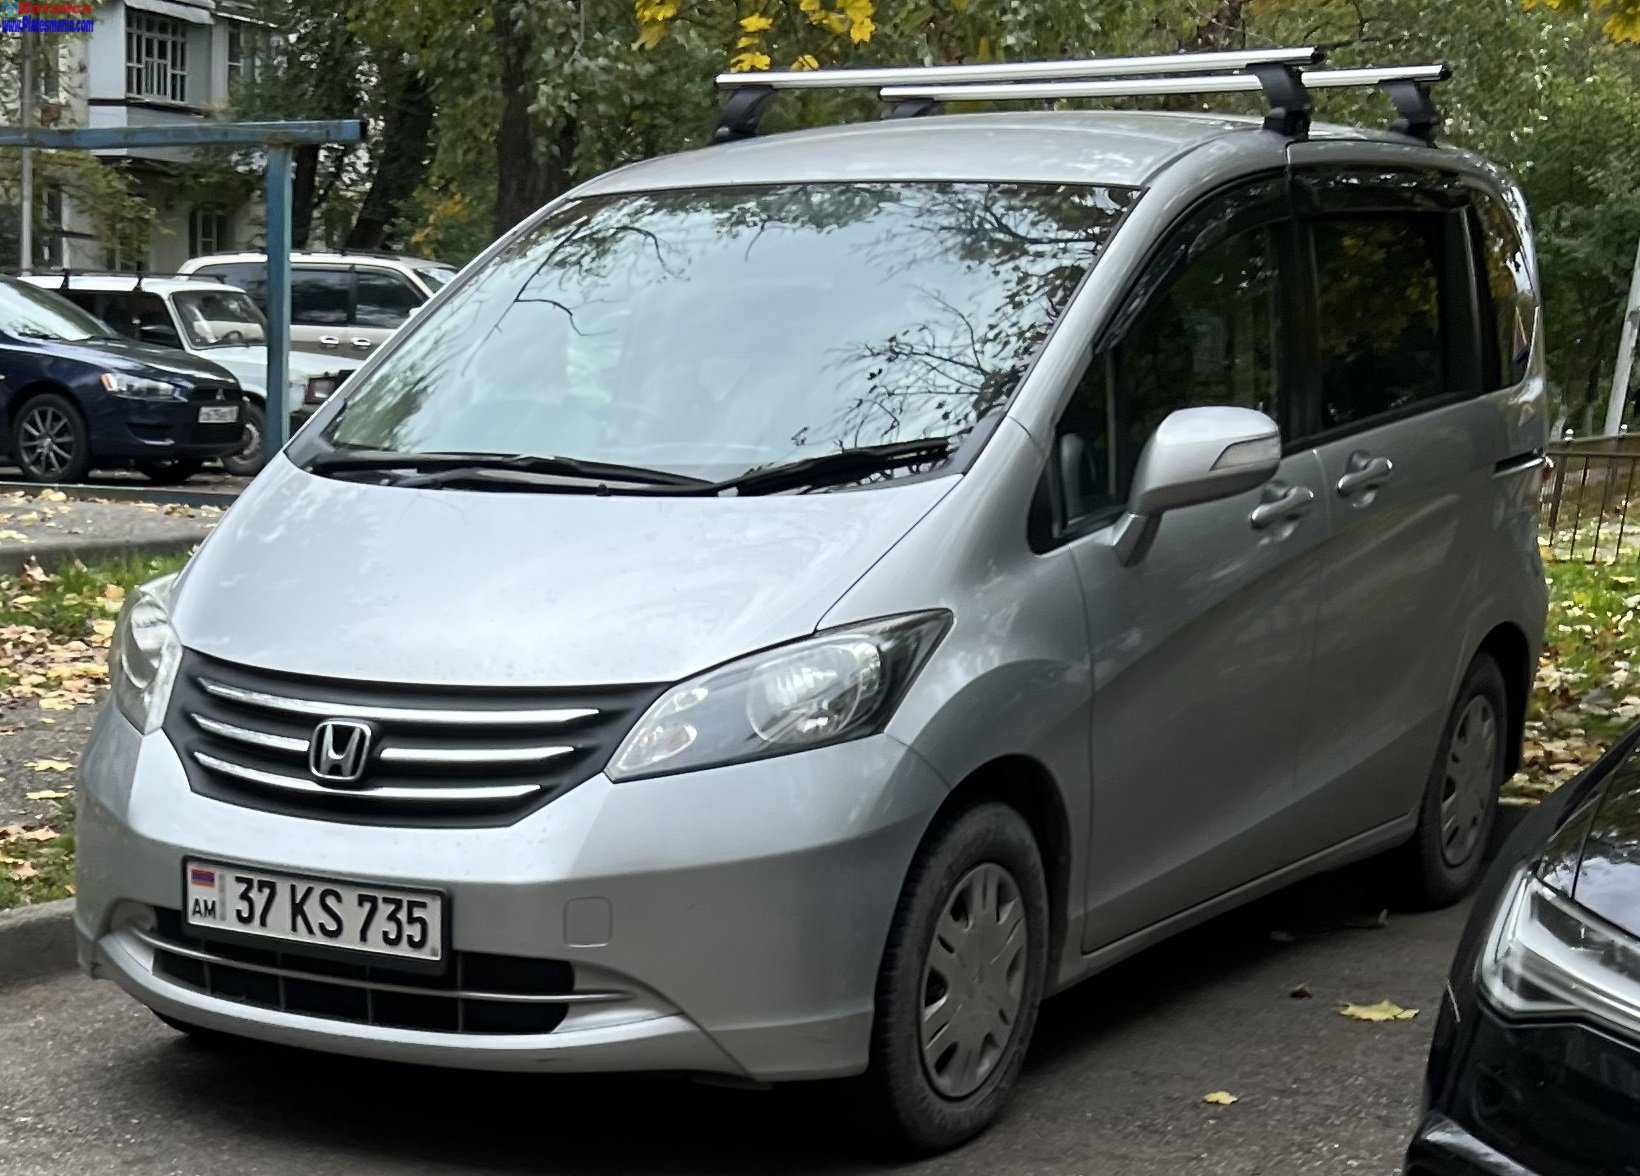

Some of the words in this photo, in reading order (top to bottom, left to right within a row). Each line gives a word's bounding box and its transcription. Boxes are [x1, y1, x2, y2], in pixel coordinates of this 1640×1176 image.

[192, 898, 216, 919] AM
[235, 876, 277, 927] 37
[290, 884, 343, 938] KS
[358, 894, 427, 949] 735
